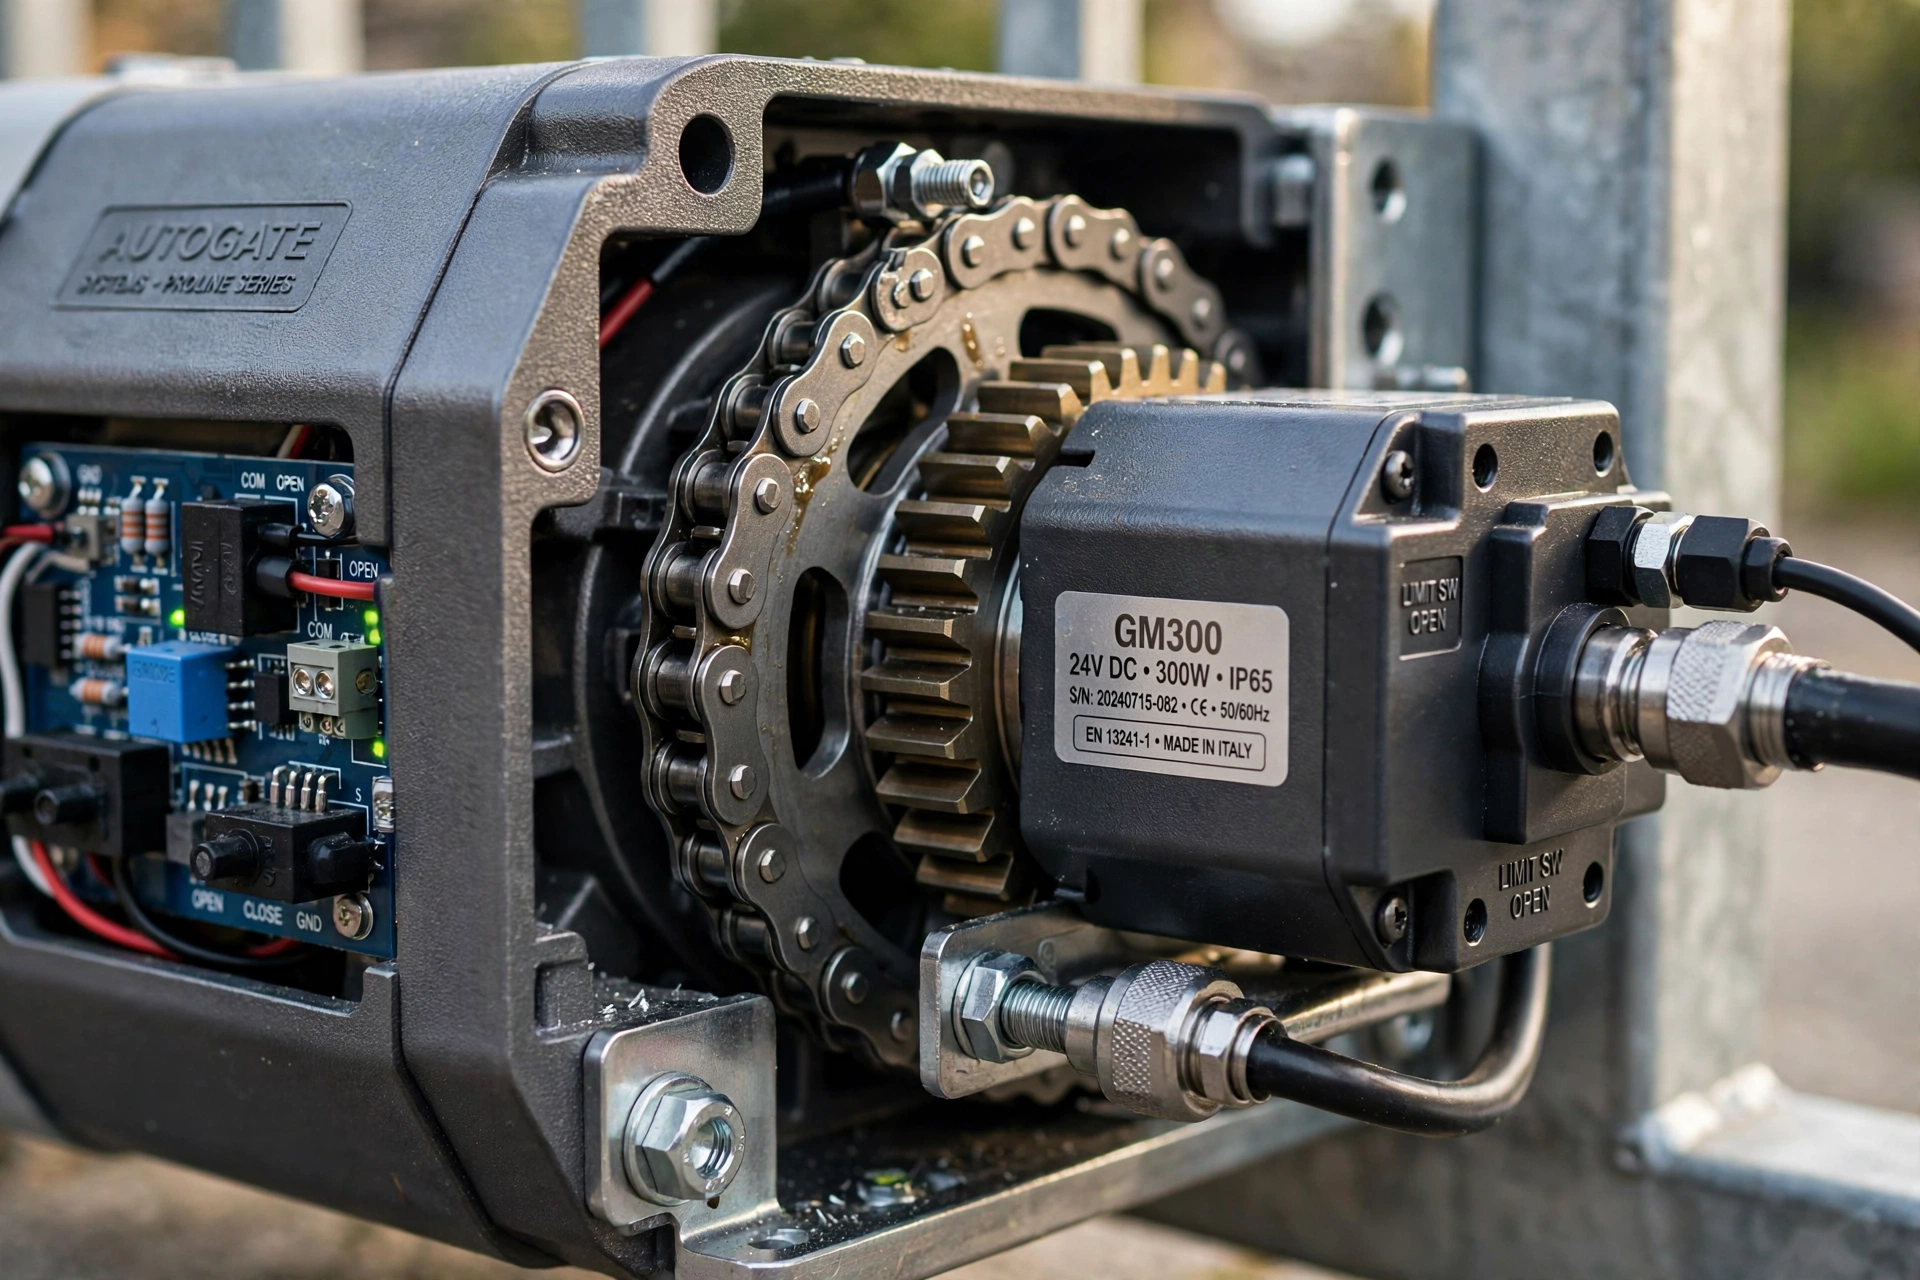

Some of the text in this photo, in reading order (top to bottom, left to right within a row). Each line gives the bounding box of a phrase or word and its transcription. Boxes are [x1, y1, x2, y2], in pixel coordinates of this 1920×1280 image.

[99, 221, 322, 262] AUTOGATE
[162, 273, 235, 295] PROLINE
[233, 273, 297, 295] SERIES
[241, 472, 304, 492] COM OPEN
[350, 560, 378, 578] OPEN
[1401, 577, 1459, 606] LIMIT SW
[307, 621, 333, 639] COM
[1115, 613, 1222, 655] GM300
[1409, 608, 1447, 635] OPEN
[1069, 652, 1272, 693] 24V DC 300W IP65
[1069, 686, 1094, 705] S/N:
[1097, 689, 1178, 713] 20240715-082
[1220, 701, 1270, 722] 50/60Hz
[1086, 726, 1252, 759] EN 13241-1 MADE IN ITALY
[1499, 849, 1564, 890] LIMIT SW
[192, 889, 322, 932] OPEN CLOSE GND
[1510, 885, 1551, 919] OPEN
